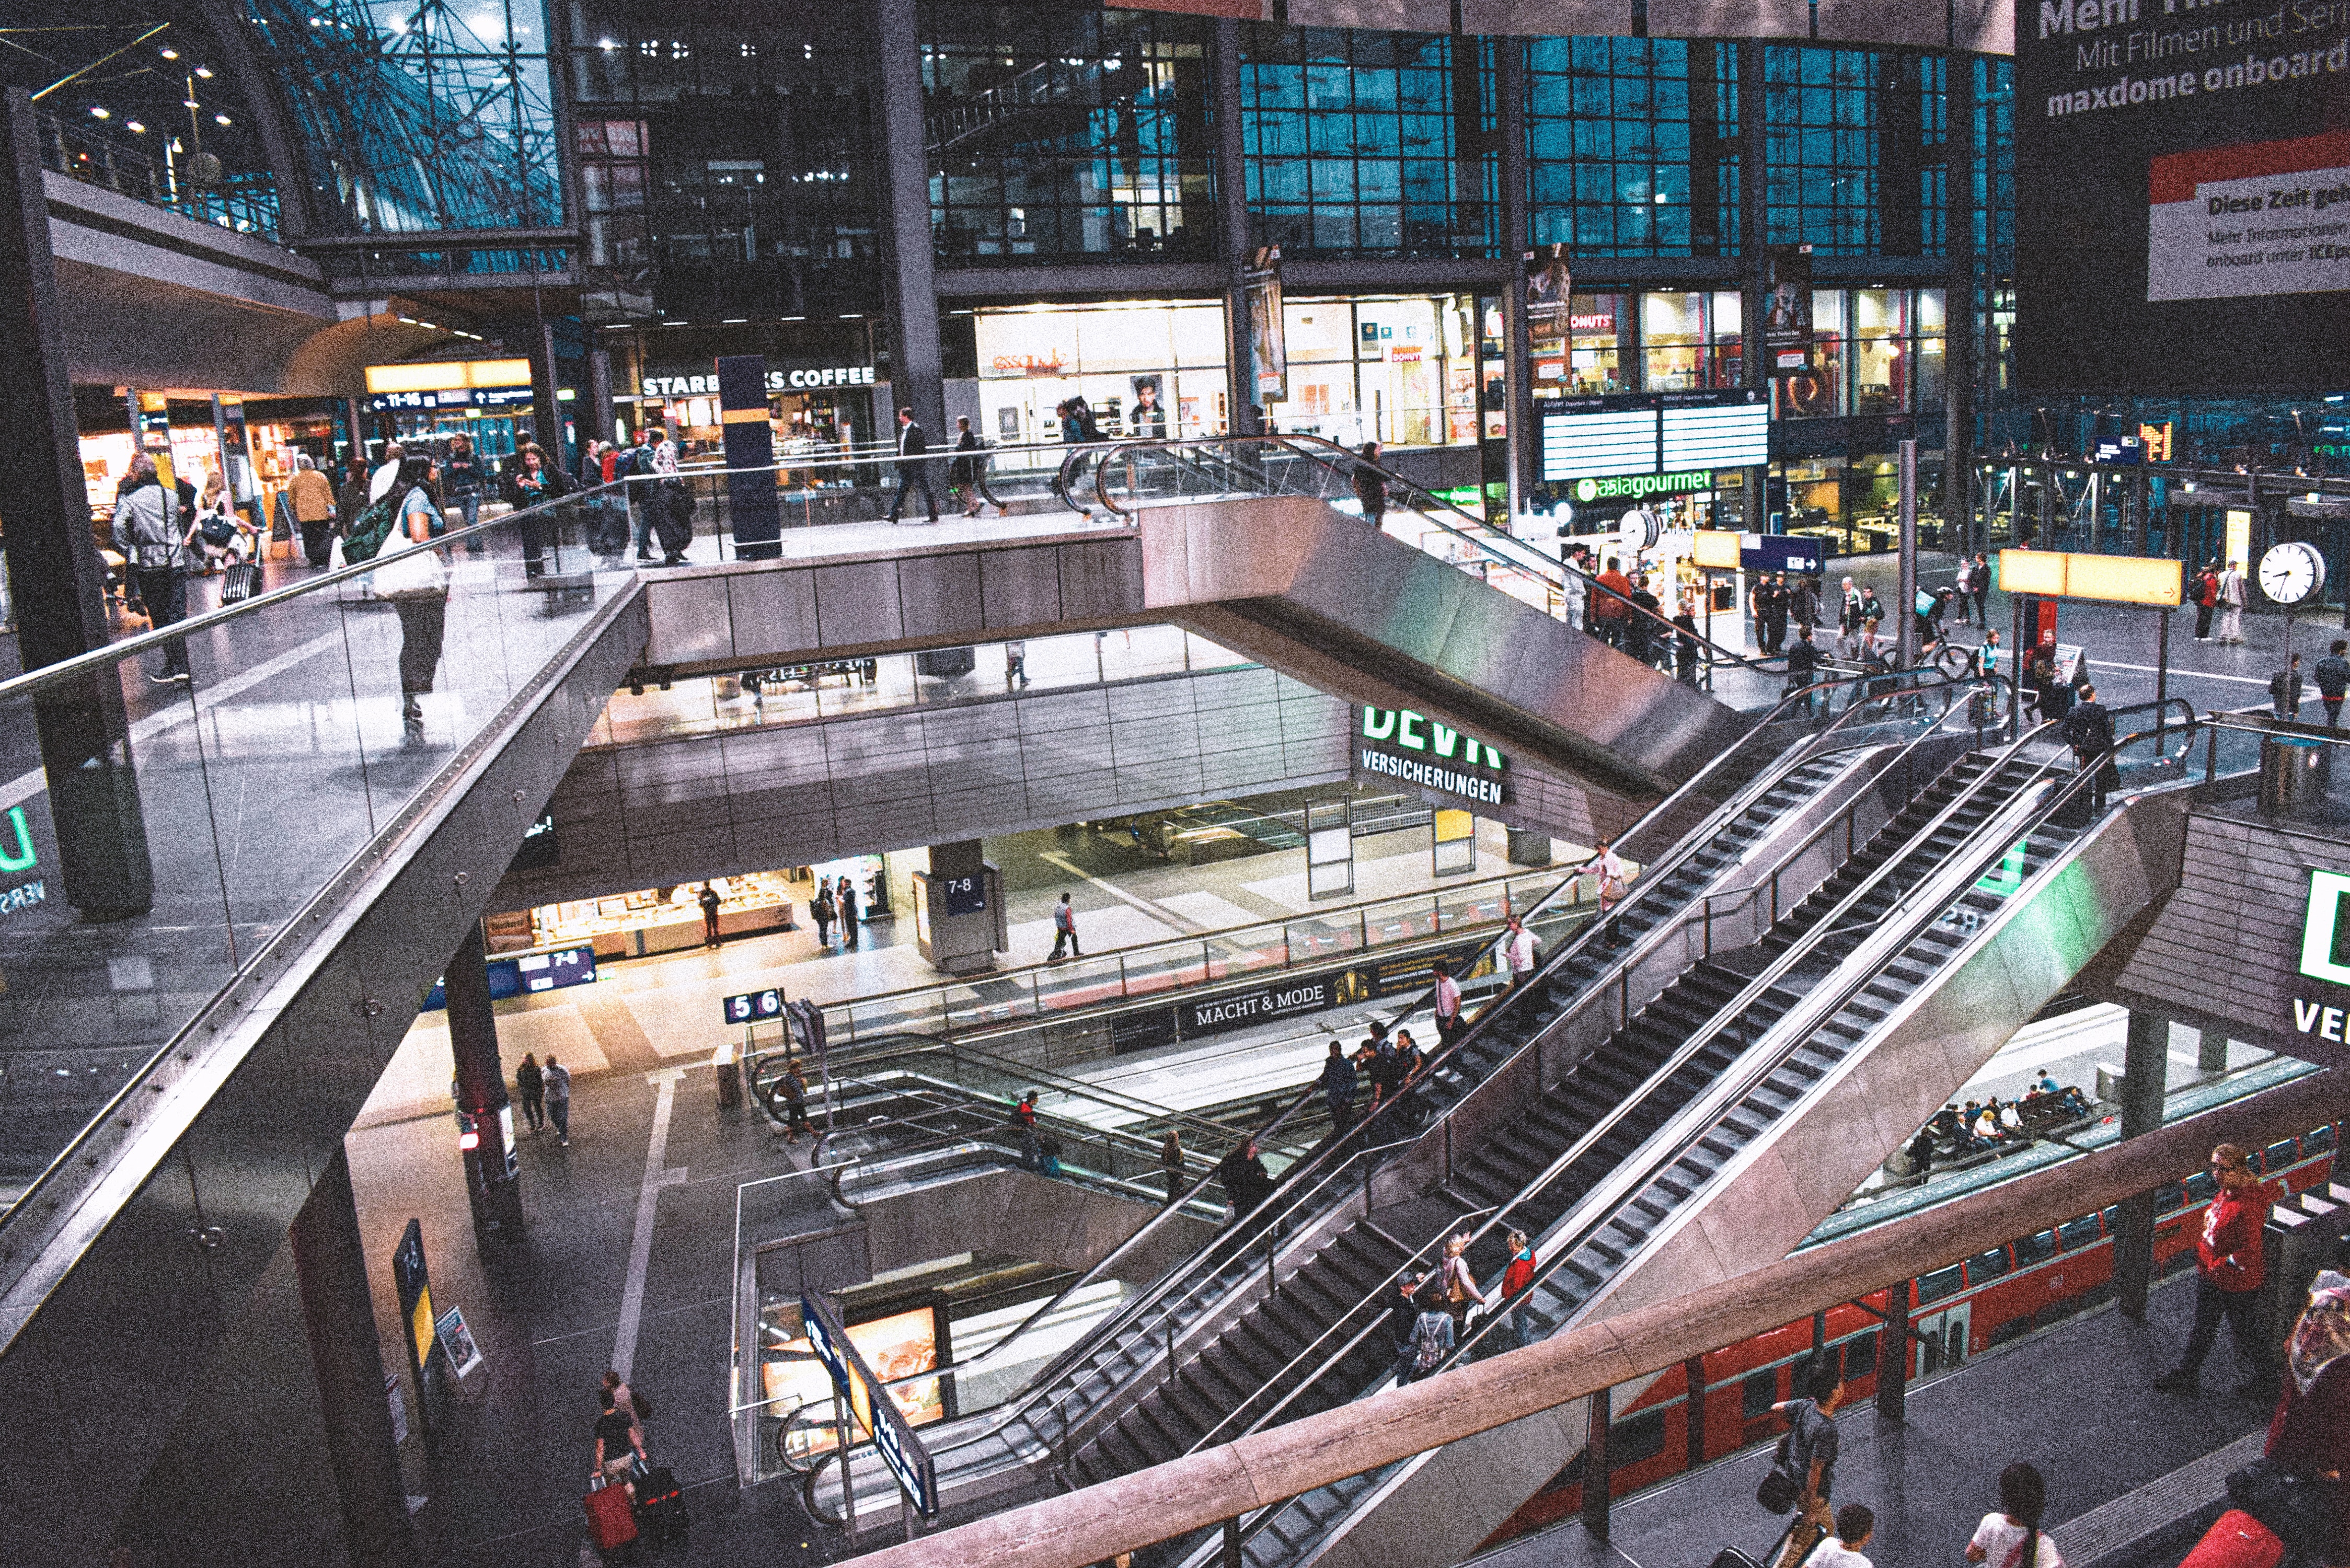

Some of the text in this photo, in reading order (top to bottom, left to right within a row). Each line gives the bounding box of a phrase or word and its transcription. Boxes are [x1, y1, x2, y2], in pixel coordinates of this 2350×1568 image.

[2077, 40, 2119, 71] Mit
[2127, 25, 2218, 63] Filmen
[2228, 4, 2283, 45] und
[2047, 37, 2349, 117] maxdome onboard
[2209, 194, 2263, 215] Diese
[2268, 187, 2310, 209] Zeit
[1570, 315, 1610, 329] ONUTS
[790, 367, 875, 388] COFFEE
[1362, 749, 1502, 804] VERSICHERUNGEN
[948, 878, 972, 894] 7-8
[734, 996, 751, 1017] 5
[762, 991, 778, 1012] 6
[1196, 985, 1324, 1027] MACHT & MODE
[2294, 998, 2350, 1045] VE
